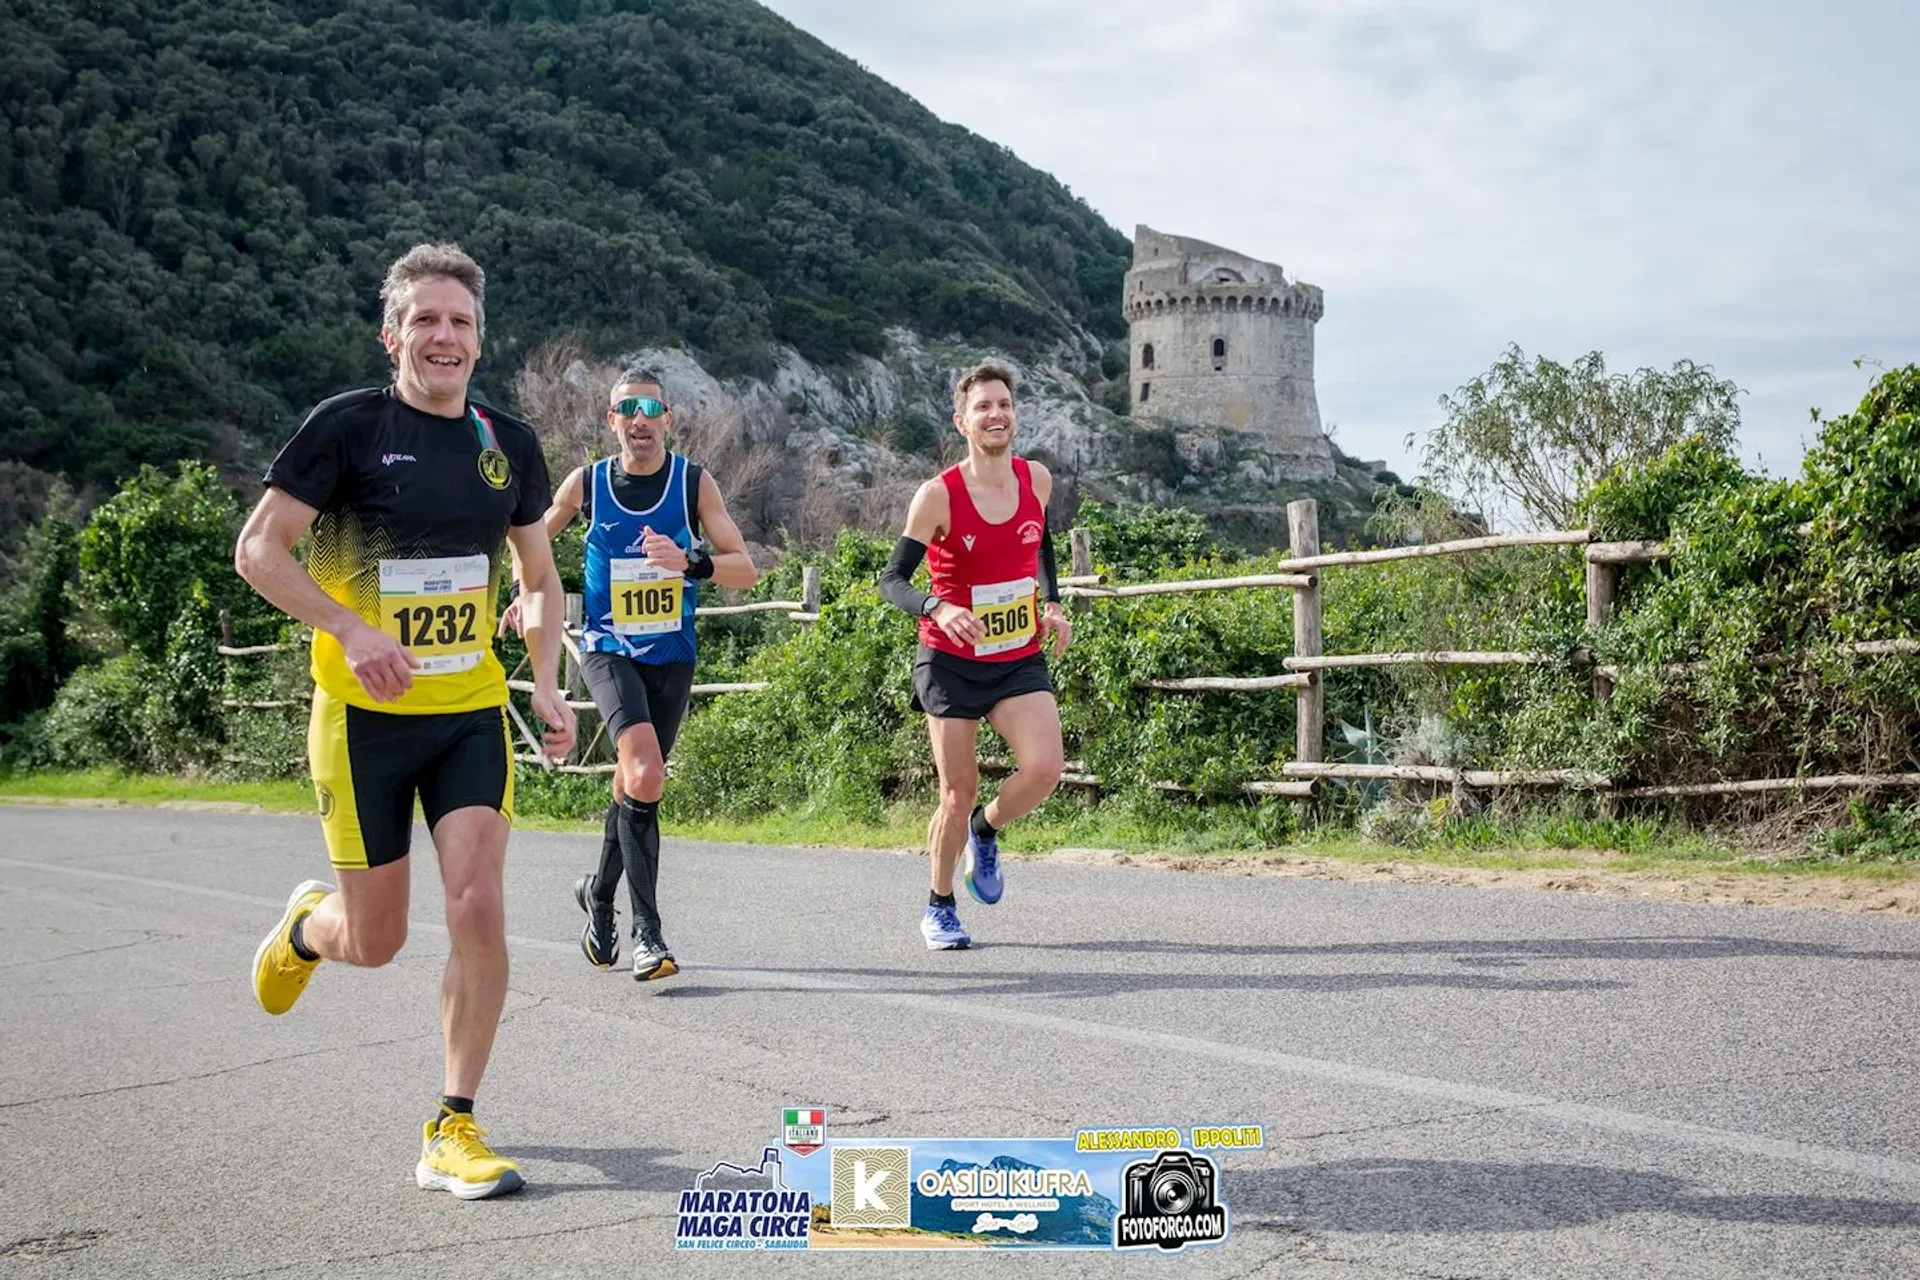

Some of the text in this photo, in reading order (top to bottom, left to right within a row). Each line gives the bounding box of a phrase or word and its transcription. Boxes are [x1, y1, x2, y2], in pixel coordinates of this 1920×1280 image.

[621, 588, 673, 616] 1105
[393, 602, 476, 647] 1232
[980, 605, 1028, 637] 1506
